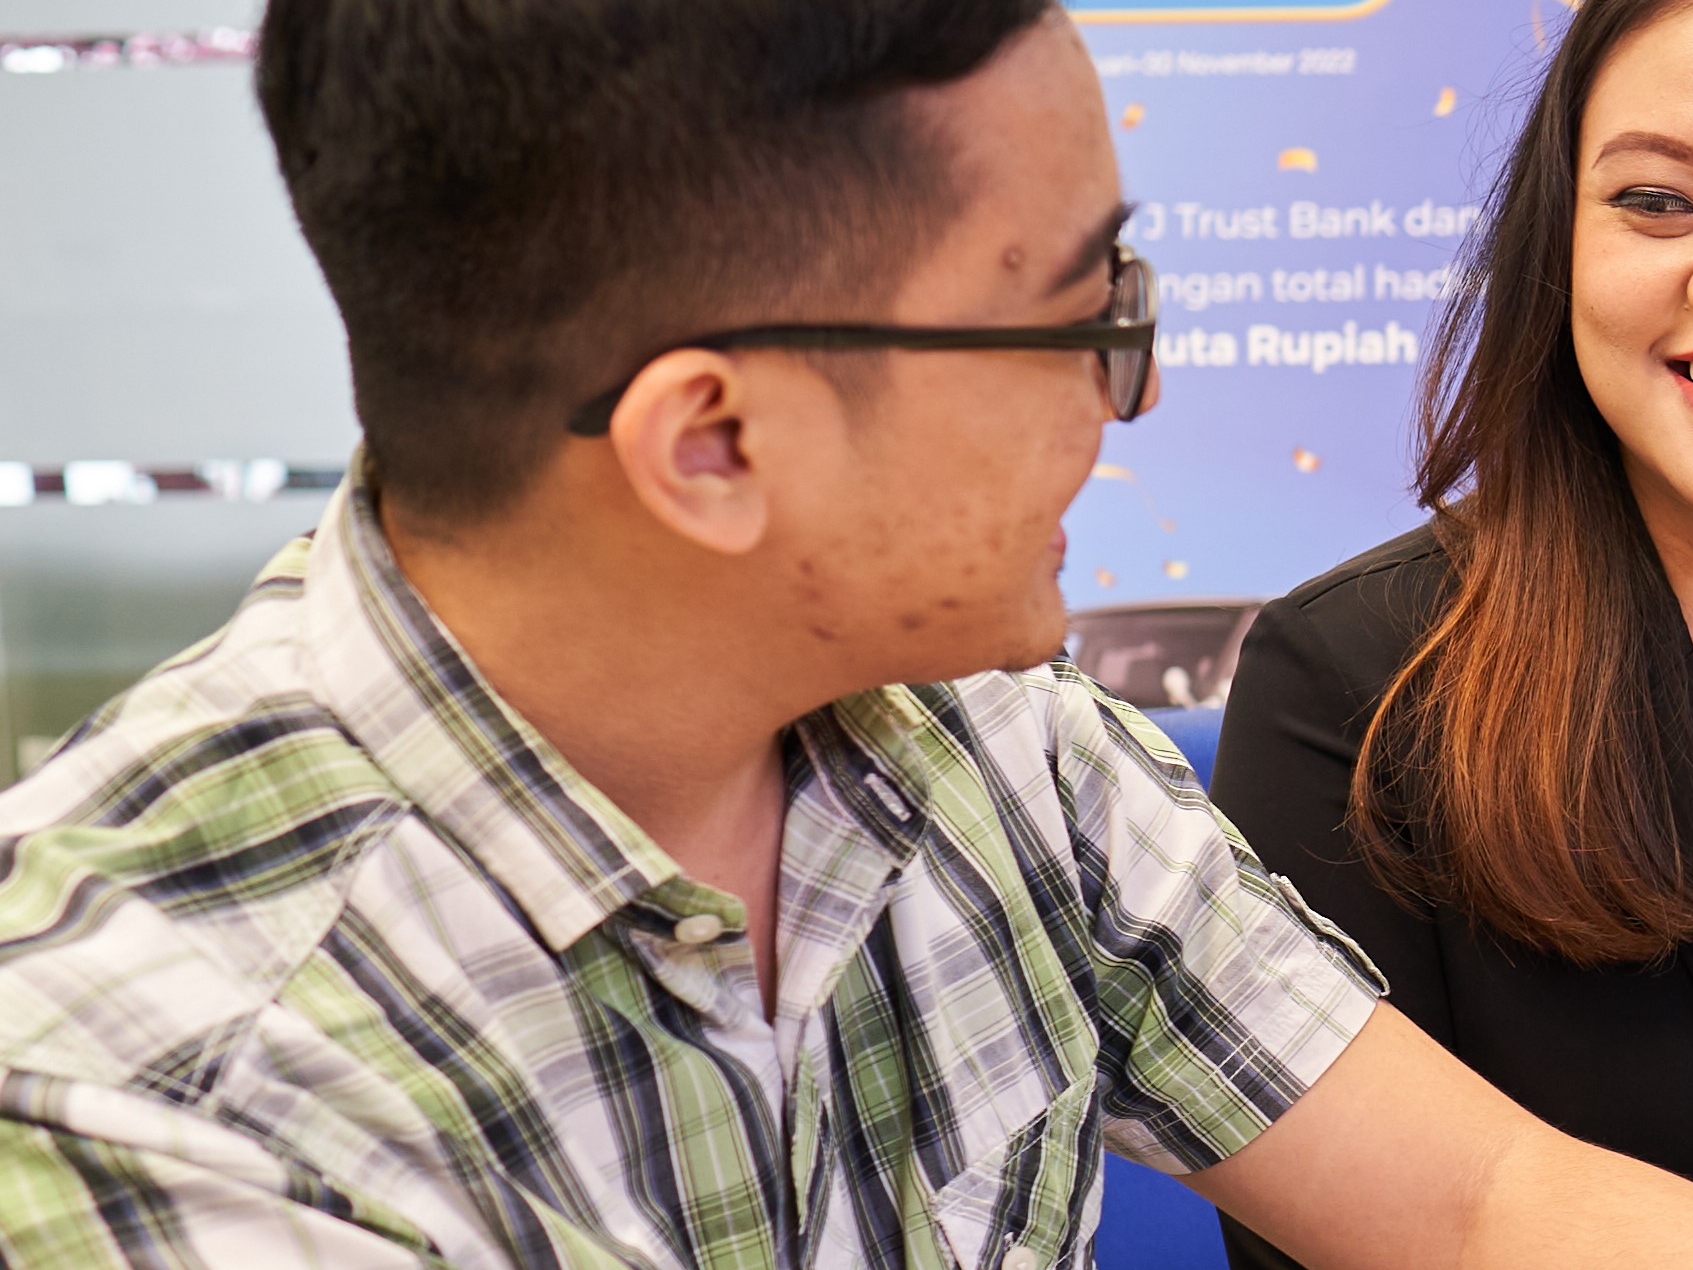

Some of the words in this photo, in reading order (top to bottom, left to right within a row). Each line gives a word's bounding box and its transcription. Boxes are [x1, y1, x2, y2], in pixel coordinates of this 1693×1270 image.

[1178, 50, 1295, 76] November
[1143, 202, 1167, 241] J
[1173, 201, 1280, 240] Trust
[1289, 199, 1398, 239] Bank
[1158, 271, 1264, 311] ngan
[1272, 263, 1366, 303] total
[1374, 263, 1453, 302] had
[1158, 327, 1239, 368] uta
[1248, 319, 1418, 375] Rupiah
